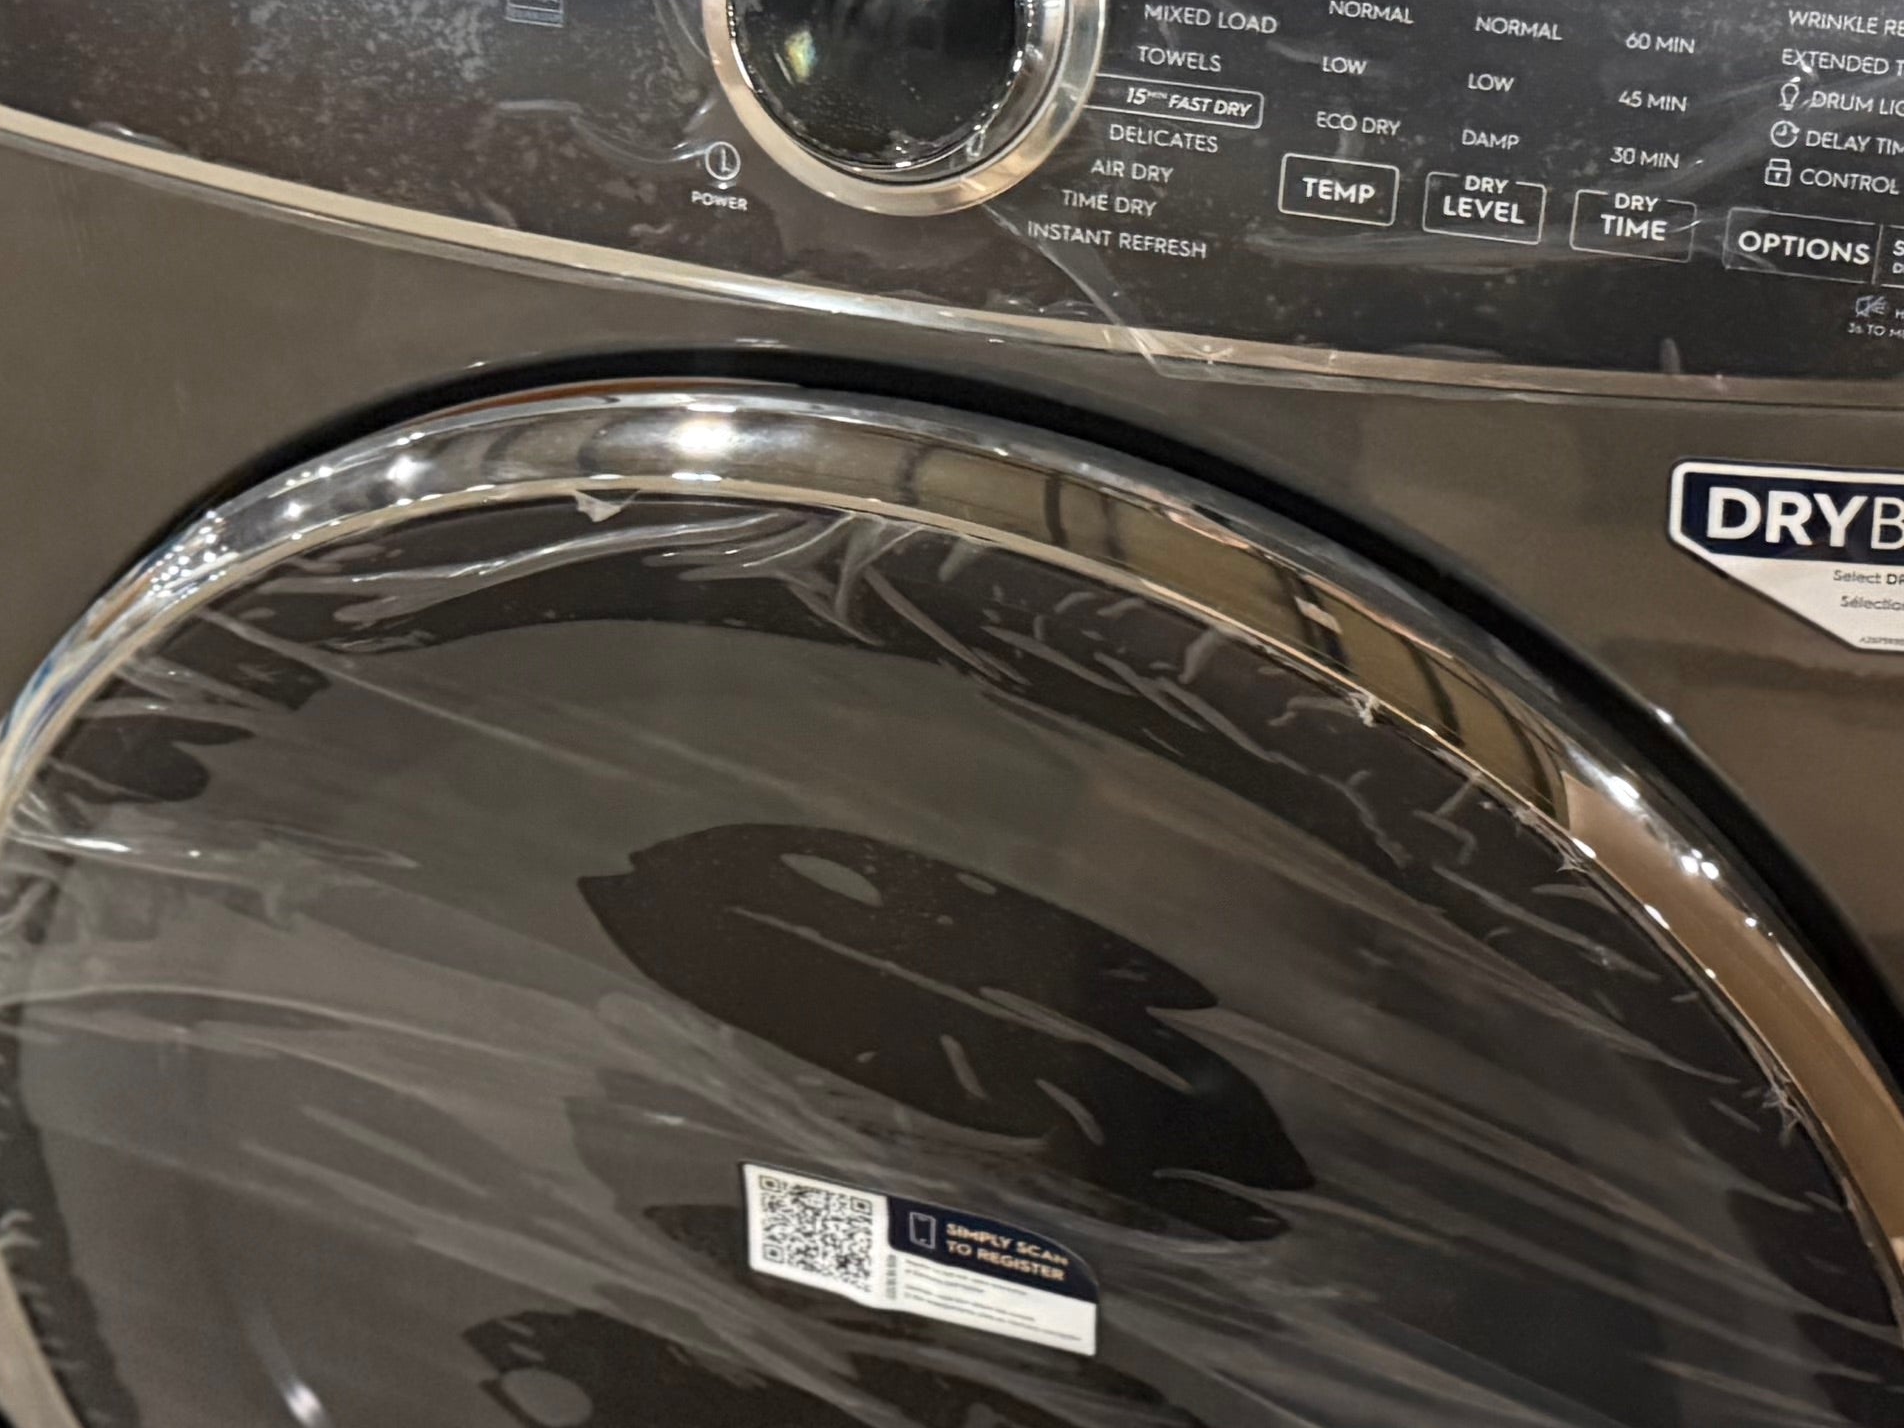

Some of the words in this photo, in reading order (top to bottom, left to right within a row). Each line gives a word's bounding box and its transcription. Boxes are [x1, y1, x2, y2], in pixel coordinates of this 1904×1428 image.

[1145, 4, 1211, 26] MIXED
[1218, 11, 1277, 34] LOAD
[1328, 0, 1414, 25] NORMAL
[1788, 9, 1879, 35] WRINKLE
[1474, 16, 1563, 41] NORMAL
[1625, 32, 1652, 50] 60
[1655, 36, 1695, 54] MIN
[1137, 46, 1221, 72] TOWELS
[1322, 56, 1367, 75] LOW
[1782, 48, 1889, 75] EXTENDED
[1467, 73, 1515, 92] LOW
[1168, 94, 1212, 112] FAST
[1214, 100, 1252, 118] DRY
[1618, 90, 1643, 108] 45
[1647, 93, 1688, 112] MIN
[1810, 90, 1874, 113] DRUM
[1316, 111, 1357, 131] ECO
[1361, 117, 1401, 136] DRY
[1110, 124, 1219, 153] DELICATES
[1462, 129, 1521, 151] DAMP
[1805, 130, 1871, 153] DELAY
[1609, 146, 1636, 164] 30
[1640, 150, 1680, 169] MIN
[1090, 159, 1125, 177] AIR
[1131, 163, 1174, 184] DRY
[1799, 168, 1900, 195] CONTROL
[1302, 177, 1376, 205] TEMP
[1464, 175, 1509, 194] DRY
[691, 190, 748, 211] POWER
[1061, 189, 1109, 211] TIME
[1114, 196, 1157, 217] DRY
[1443, 195, 1525, 225] LEVEL
[1614, 193, 1659, 212] DRY
[1027, 221, 1111, 247] INSTANT
[1119, 232, 1207, 259] REFRESH
[1600, 214, 1668, 241] TIME
[1738, 230, 1870, 265] OPTIONS
[1867, 324, 1885, 337] TO
[1833, 570, 1881, 584] Select
[946, 1223, 1013, 1250] SIMPLY
[1016, 1241, 1069, 1266] SCAN
[946, 1240, 972, 1256] TO
[977, 1248, 1065, 1281] REGISTER
